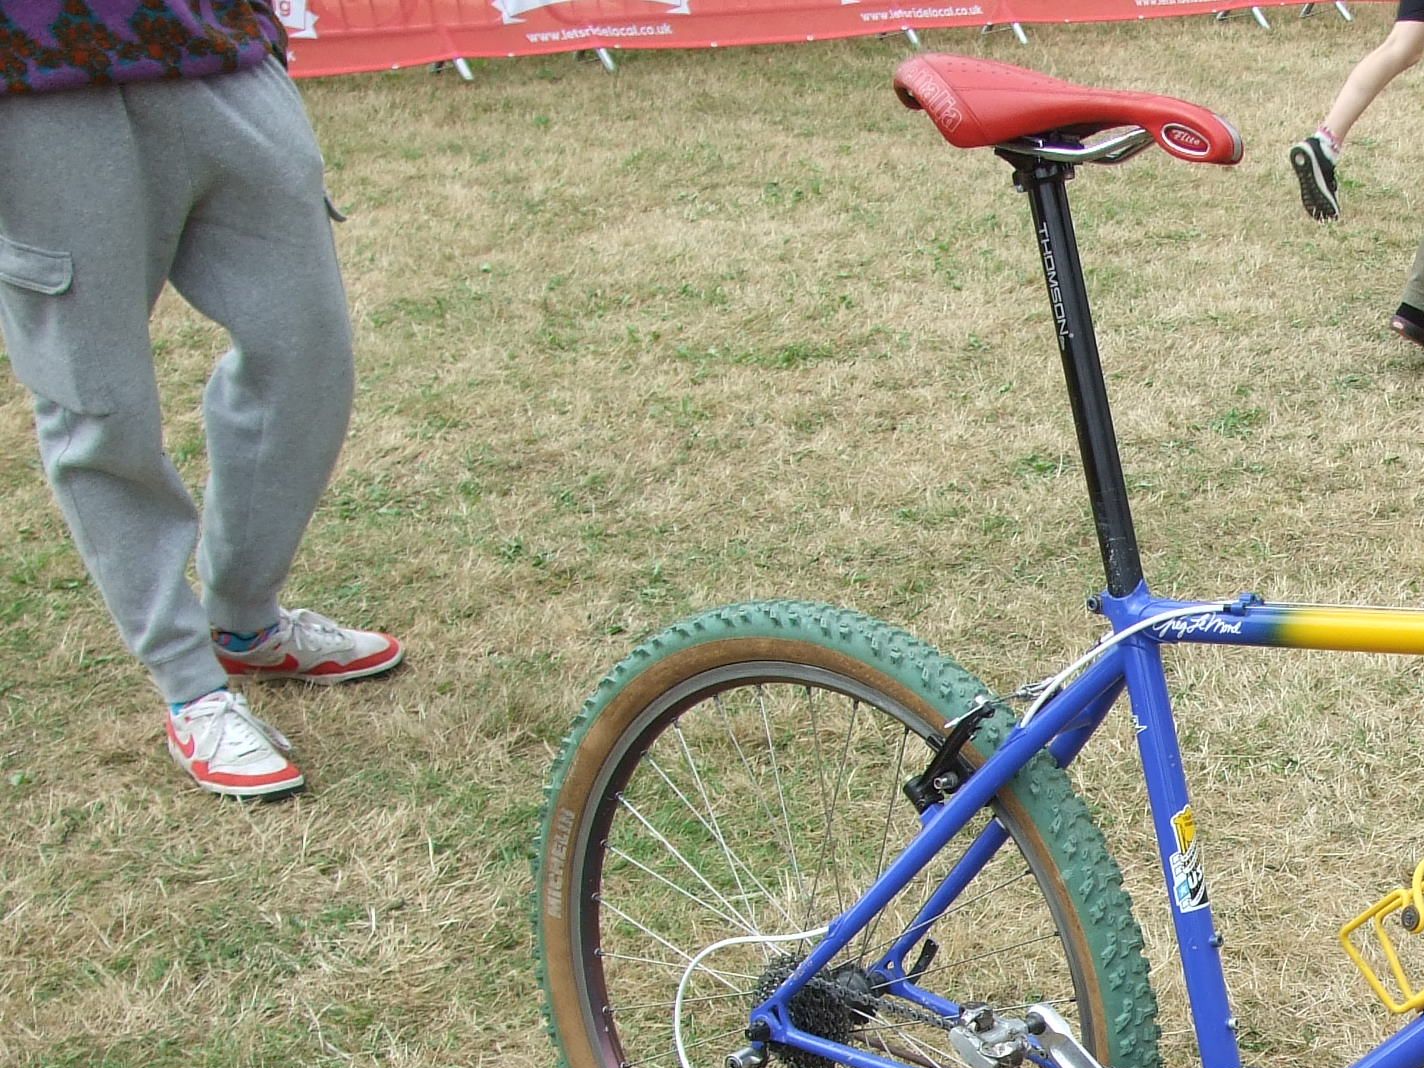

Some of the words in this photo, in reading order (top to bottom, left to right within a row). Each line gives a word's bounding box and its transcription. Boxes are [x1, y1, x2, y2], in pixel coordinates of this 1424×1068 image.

[526, 24, 672, 43] www.letsridelocal.co.uk
[1039, 221, 1069, 336] THOMSON
[547, 807, 576, 919] MICHELIN
